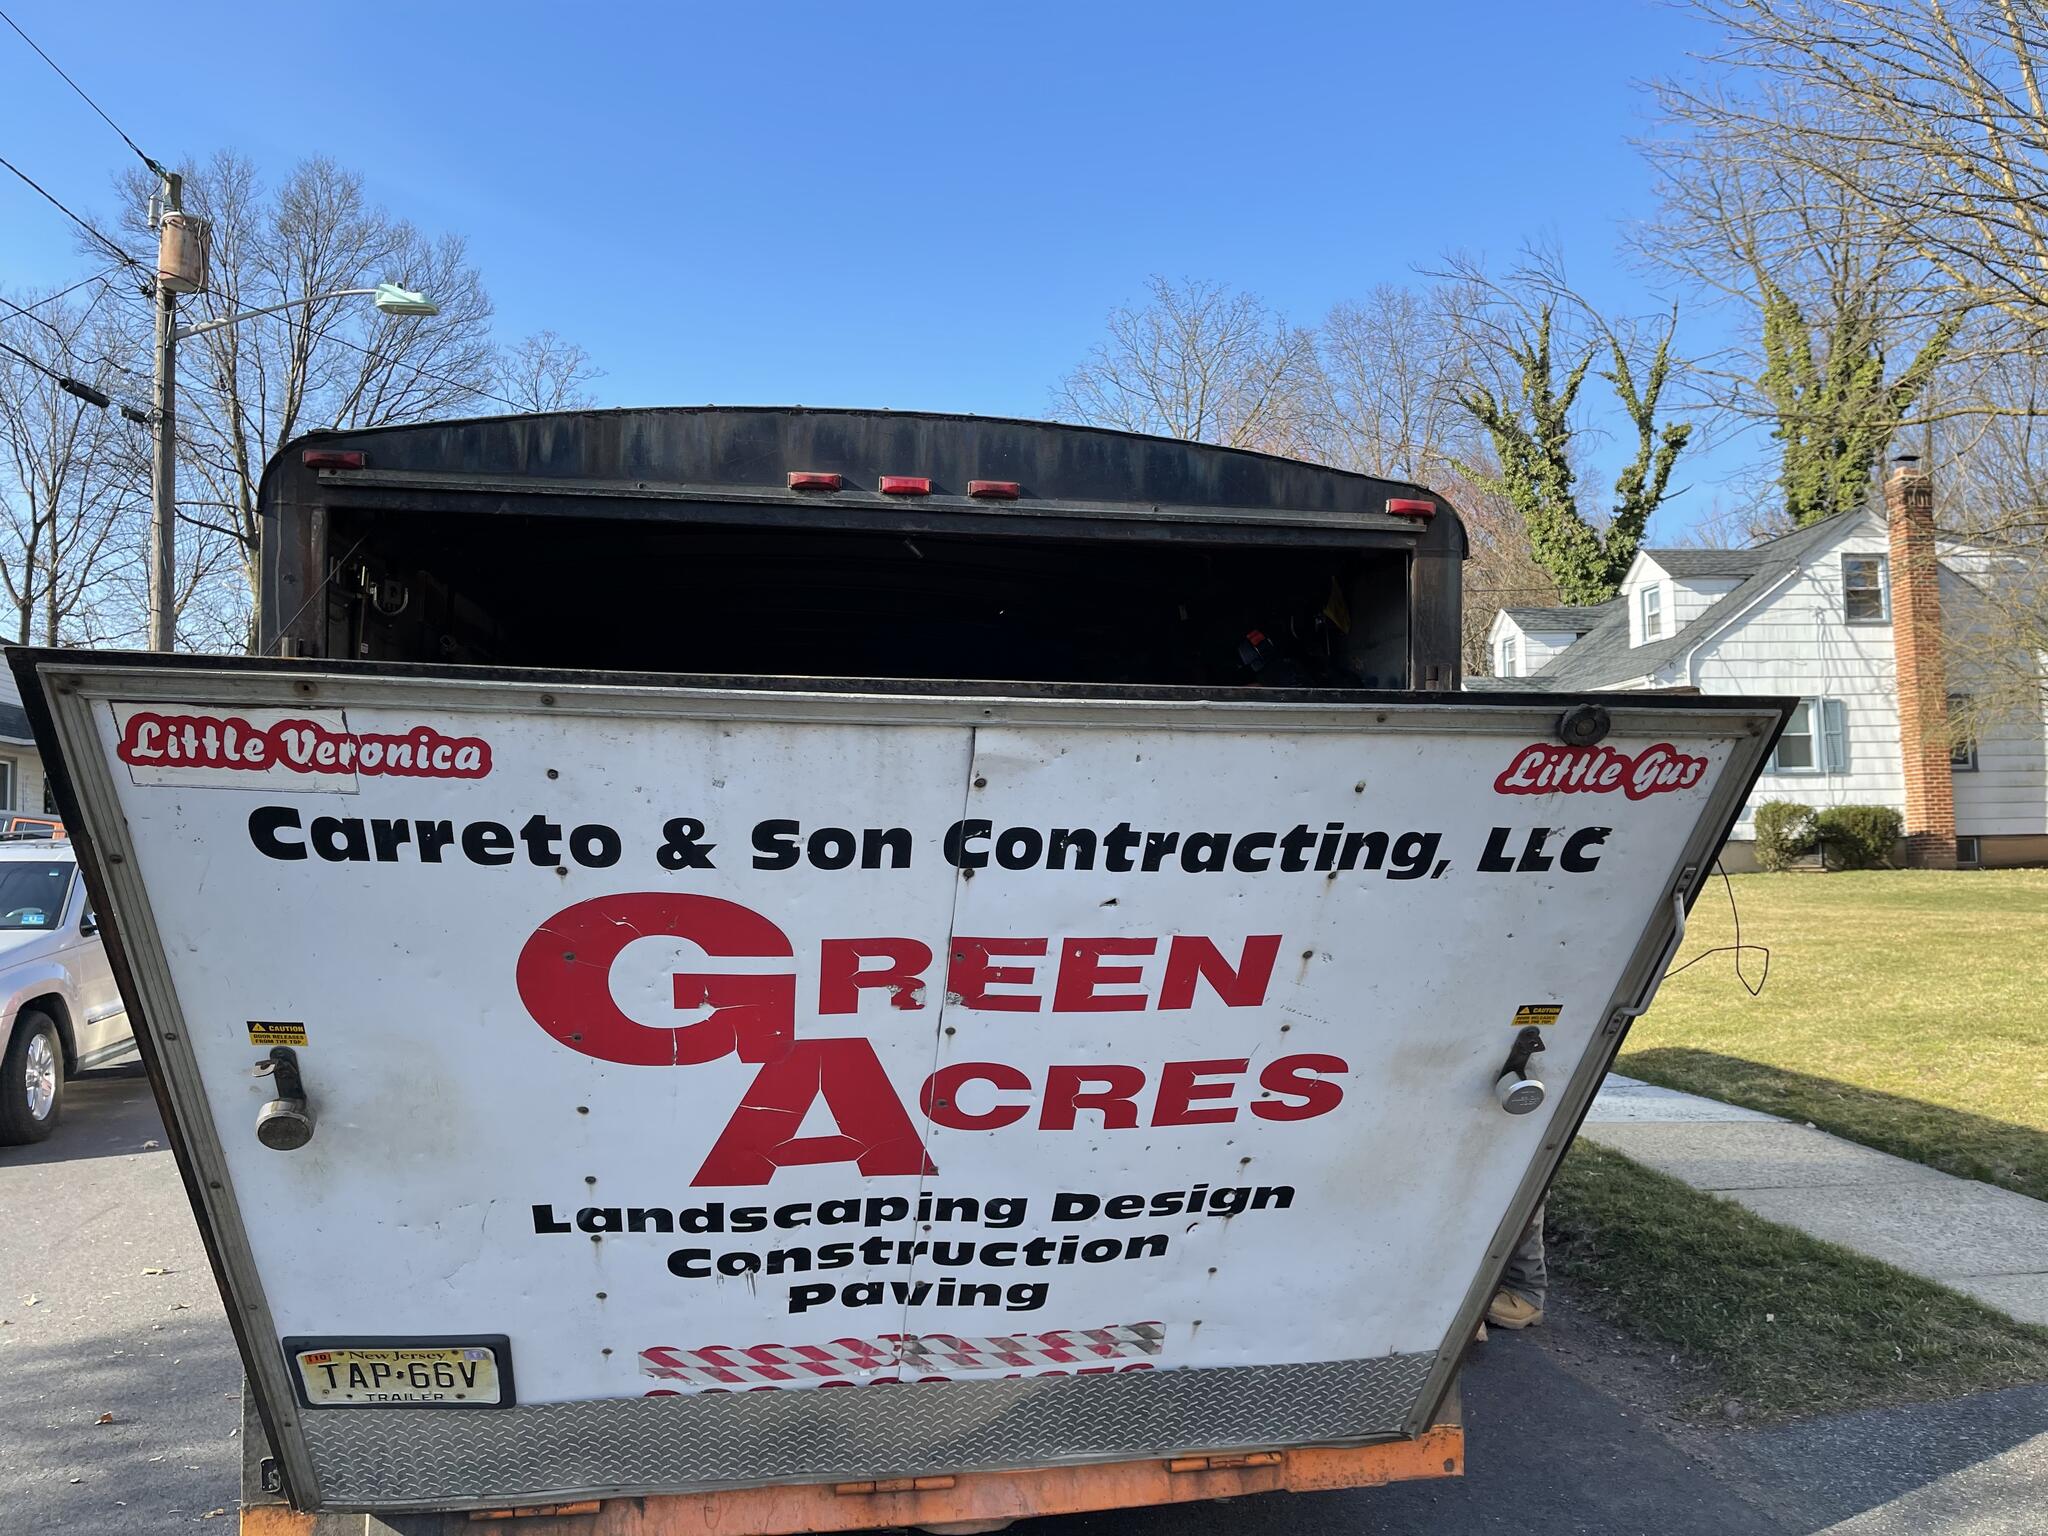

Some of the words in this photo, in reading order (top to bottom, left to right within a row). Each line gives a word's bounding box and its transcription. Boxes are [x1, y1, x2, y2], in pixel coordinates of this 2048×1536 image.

[131, 721, 266, 762] Little
[280, 728, 482, 772] Veronica
[1503, 750, 1624, 788] Little
[1631, 750, 1702, 794] Gus
[248, 805, 622, 869] Carreto
[656, 817, 717, 871] &
[751, 818, 913, 871] Son
[943, 818, 1452, 882] Contracting,
[1476, 826, 1613, 873] LLC
[516, 892, 1282, 1066] GREEN
[690, 1038, 1349, 1188] ACRES
[531, 1195, 1028, 1234] Landscaping
[1051, 1184, 1296, 1222] Design
[667, 1233, 1169, 1279] Construction
[788, 1277, 1050, 1314] Paving
[349, 1351, 392, 1360] New
[392, 1350, 447, 1364] Jersey
[365, 1392, 445, 1402] TRAILER
